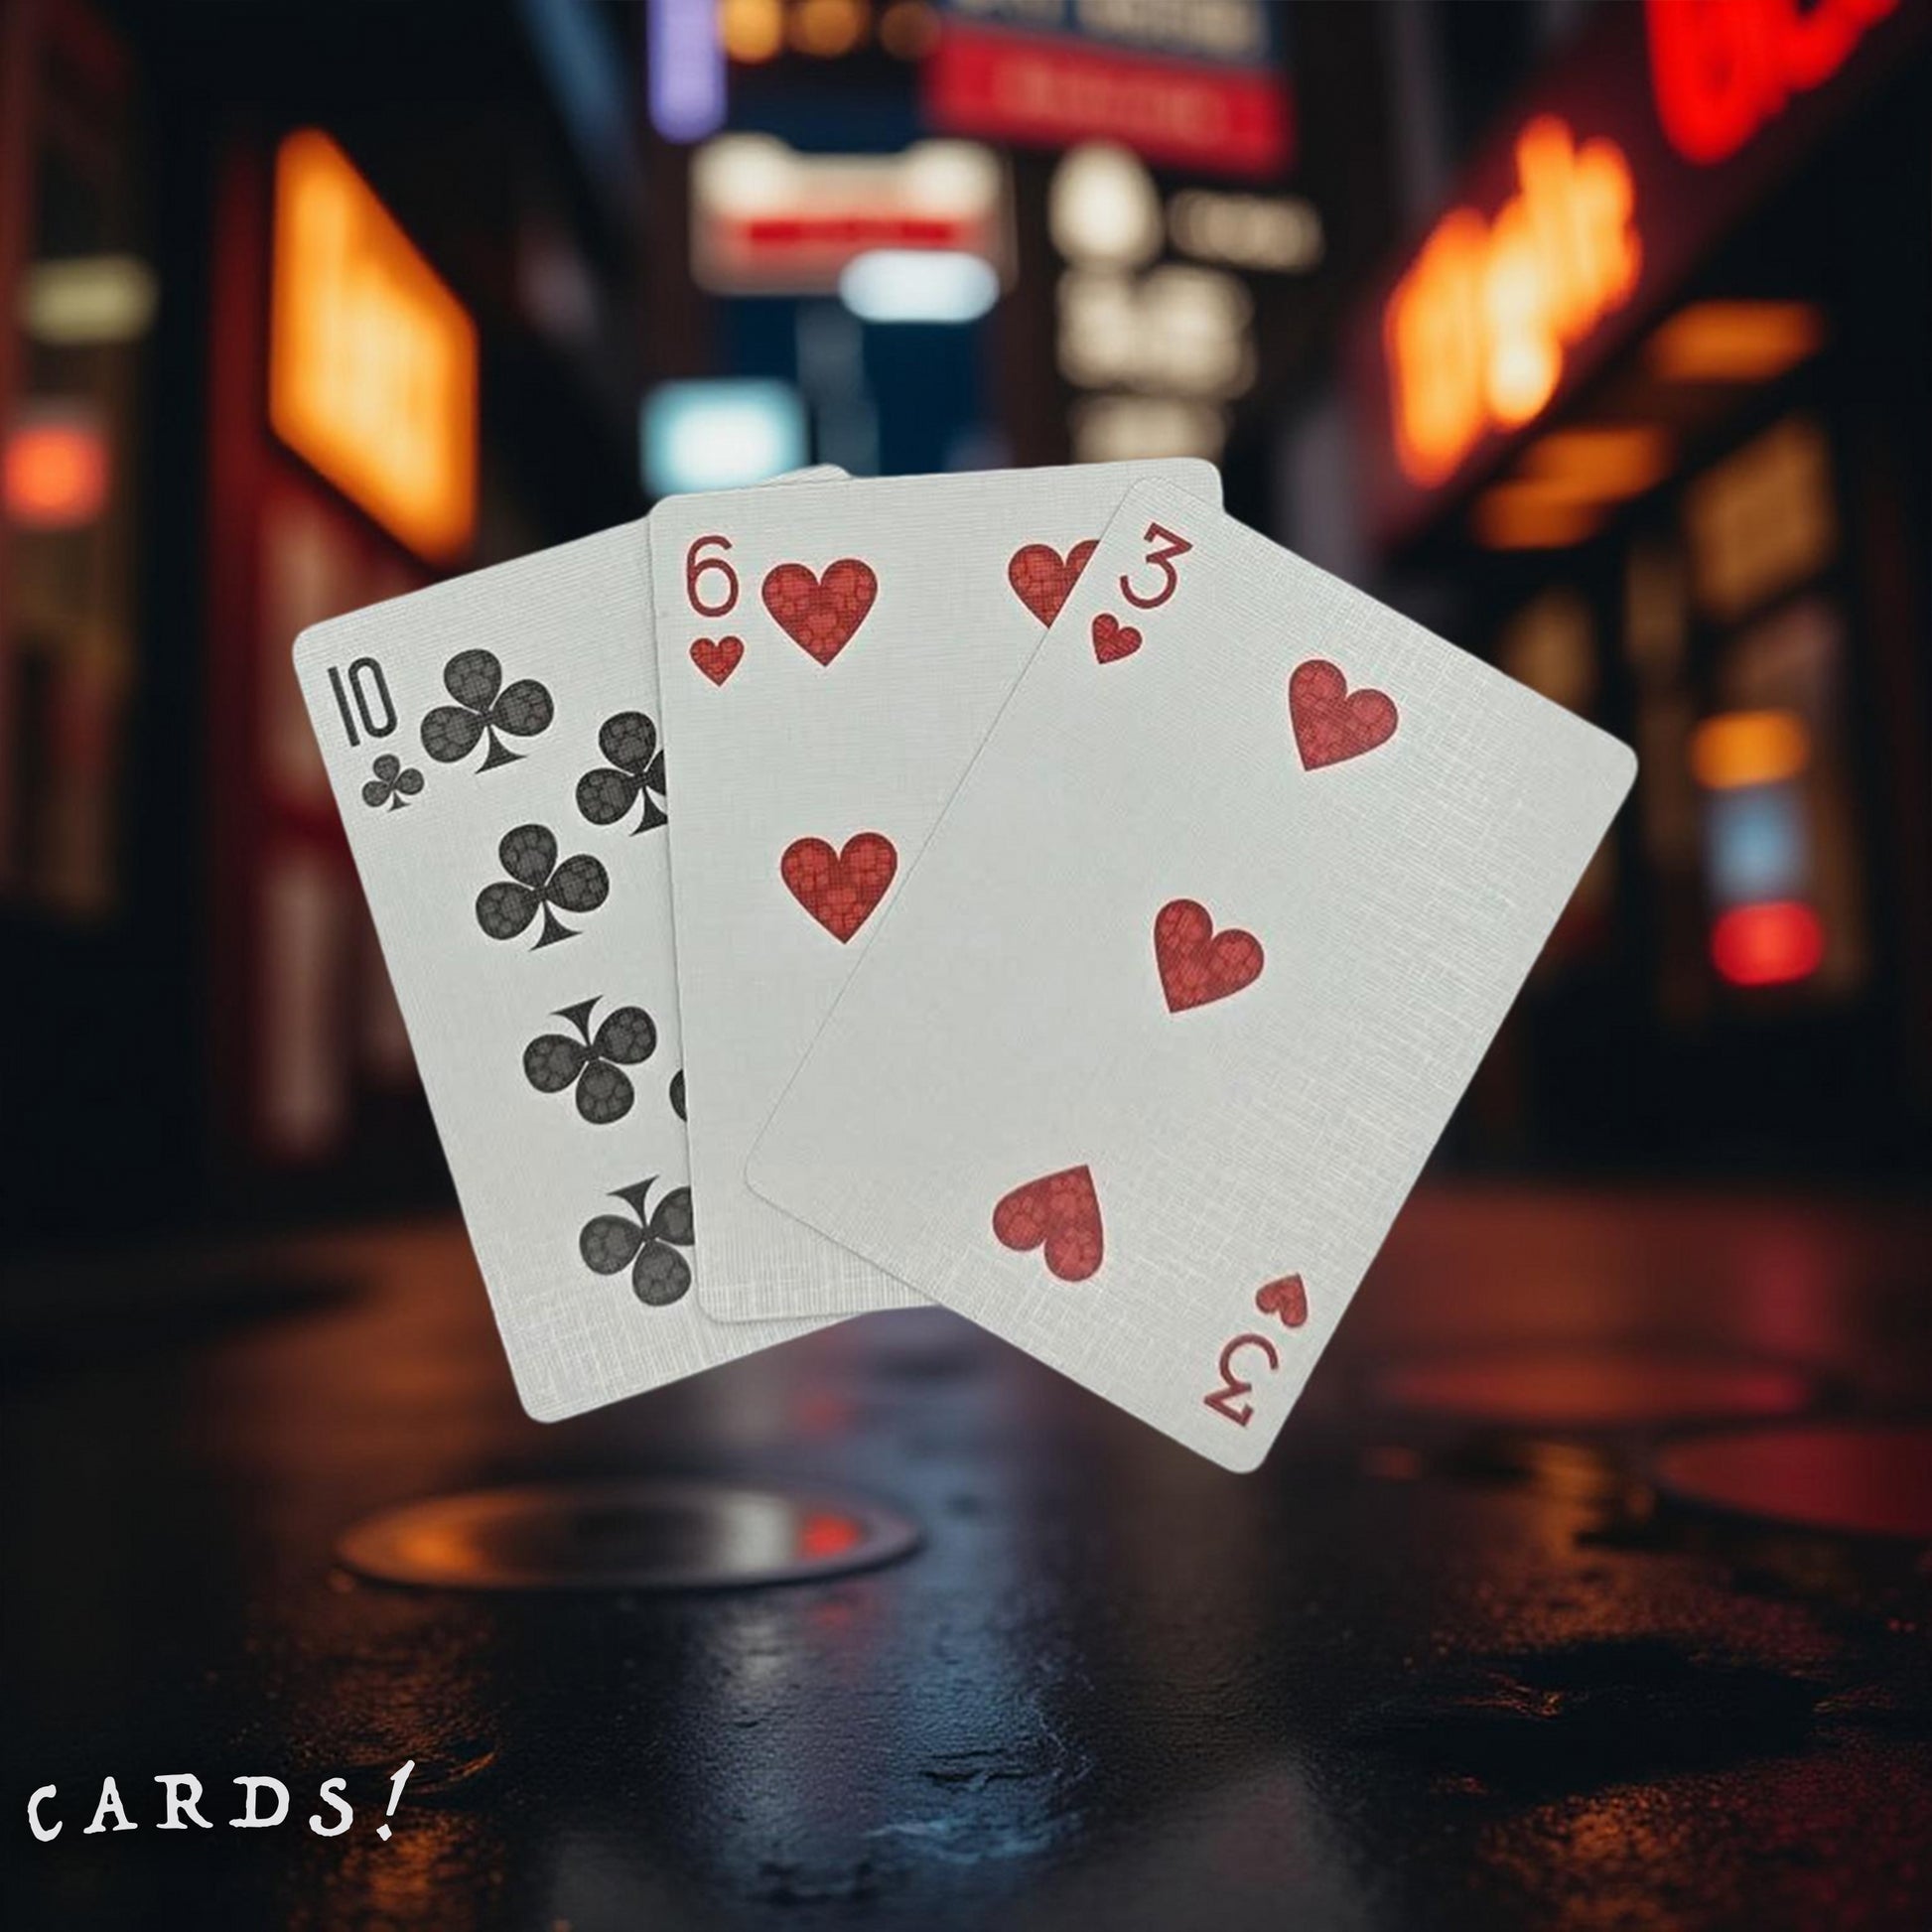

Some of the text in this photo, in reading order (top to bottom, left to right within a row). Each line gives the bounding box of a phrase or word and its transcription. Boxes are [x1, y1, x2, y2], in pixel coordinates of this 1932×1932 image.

[686, 534, 740, 618] 6
[1119, 521, 1194, 610] 3
[327, 656, 398, 748] 10
[1202, 1332, 1279, 1428] 3
